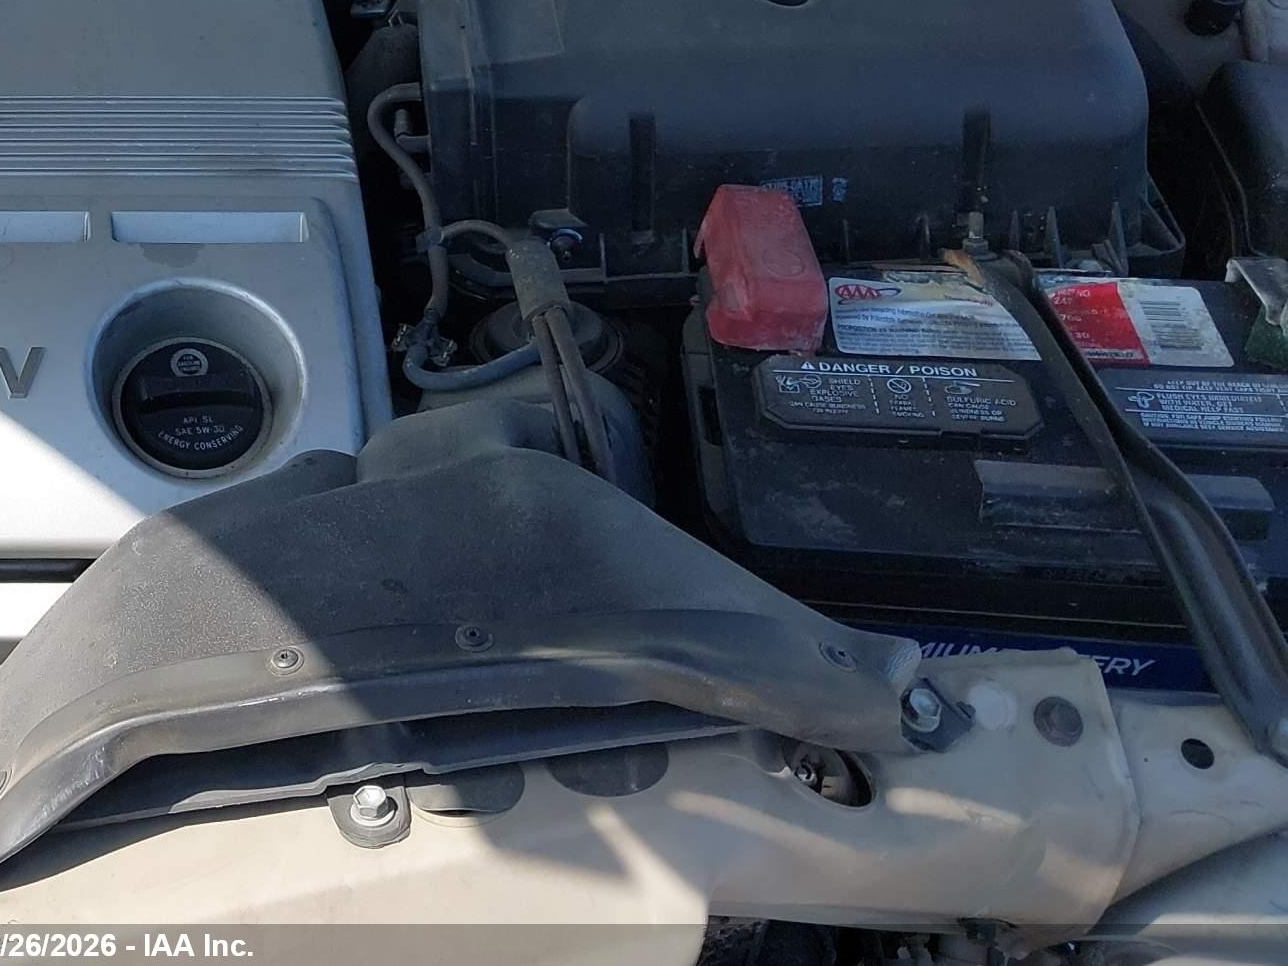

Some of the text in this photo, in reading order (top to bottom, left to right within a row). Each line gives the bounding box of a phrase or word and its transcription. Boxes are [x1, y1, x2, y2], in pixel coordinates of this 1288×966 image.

[839, 285, 874, 299] AAA
[818, 361, 890, 374] DANGER
[909, 365, 978, 377] POISON
[828, 377, 861, 386] SHIELD
[809, 388, 859, 397] EXPLOSIVE
[894, 393, 909, 401] NO
[946, 395, 1017, 406] SULFURIC ACID
[183, 415, 214, 425] API SL
[175, 427, 193, 436] SAE
[158, 424, 244, 451] ENERGY CONSERVING
